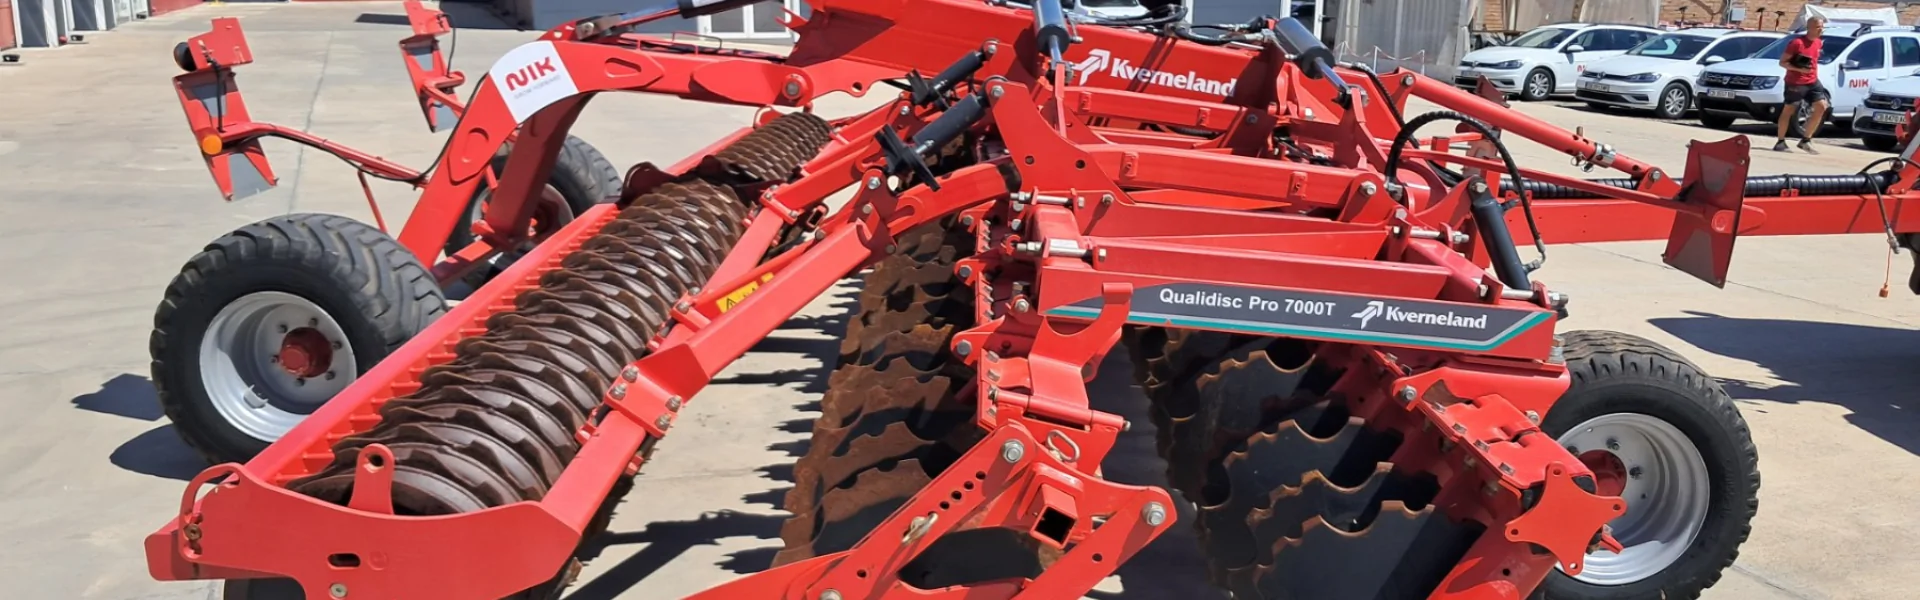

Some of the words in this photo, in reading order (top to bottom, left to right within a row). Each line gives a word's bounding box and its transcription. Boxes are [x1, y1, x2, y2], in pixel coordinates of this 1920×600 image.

[505, 56, 557, 91] NIK
[1110, 57, 1238, 98] Kverneland
[1848, 78, 1870, 89] NIK
[1158, 288, 1243, 309] Qualidisc
[1248, 295, 1279, 312] Pro
[1284, 299, 1337, 316] 7000T
[1385, 305, 1488, 330] Kverneland
